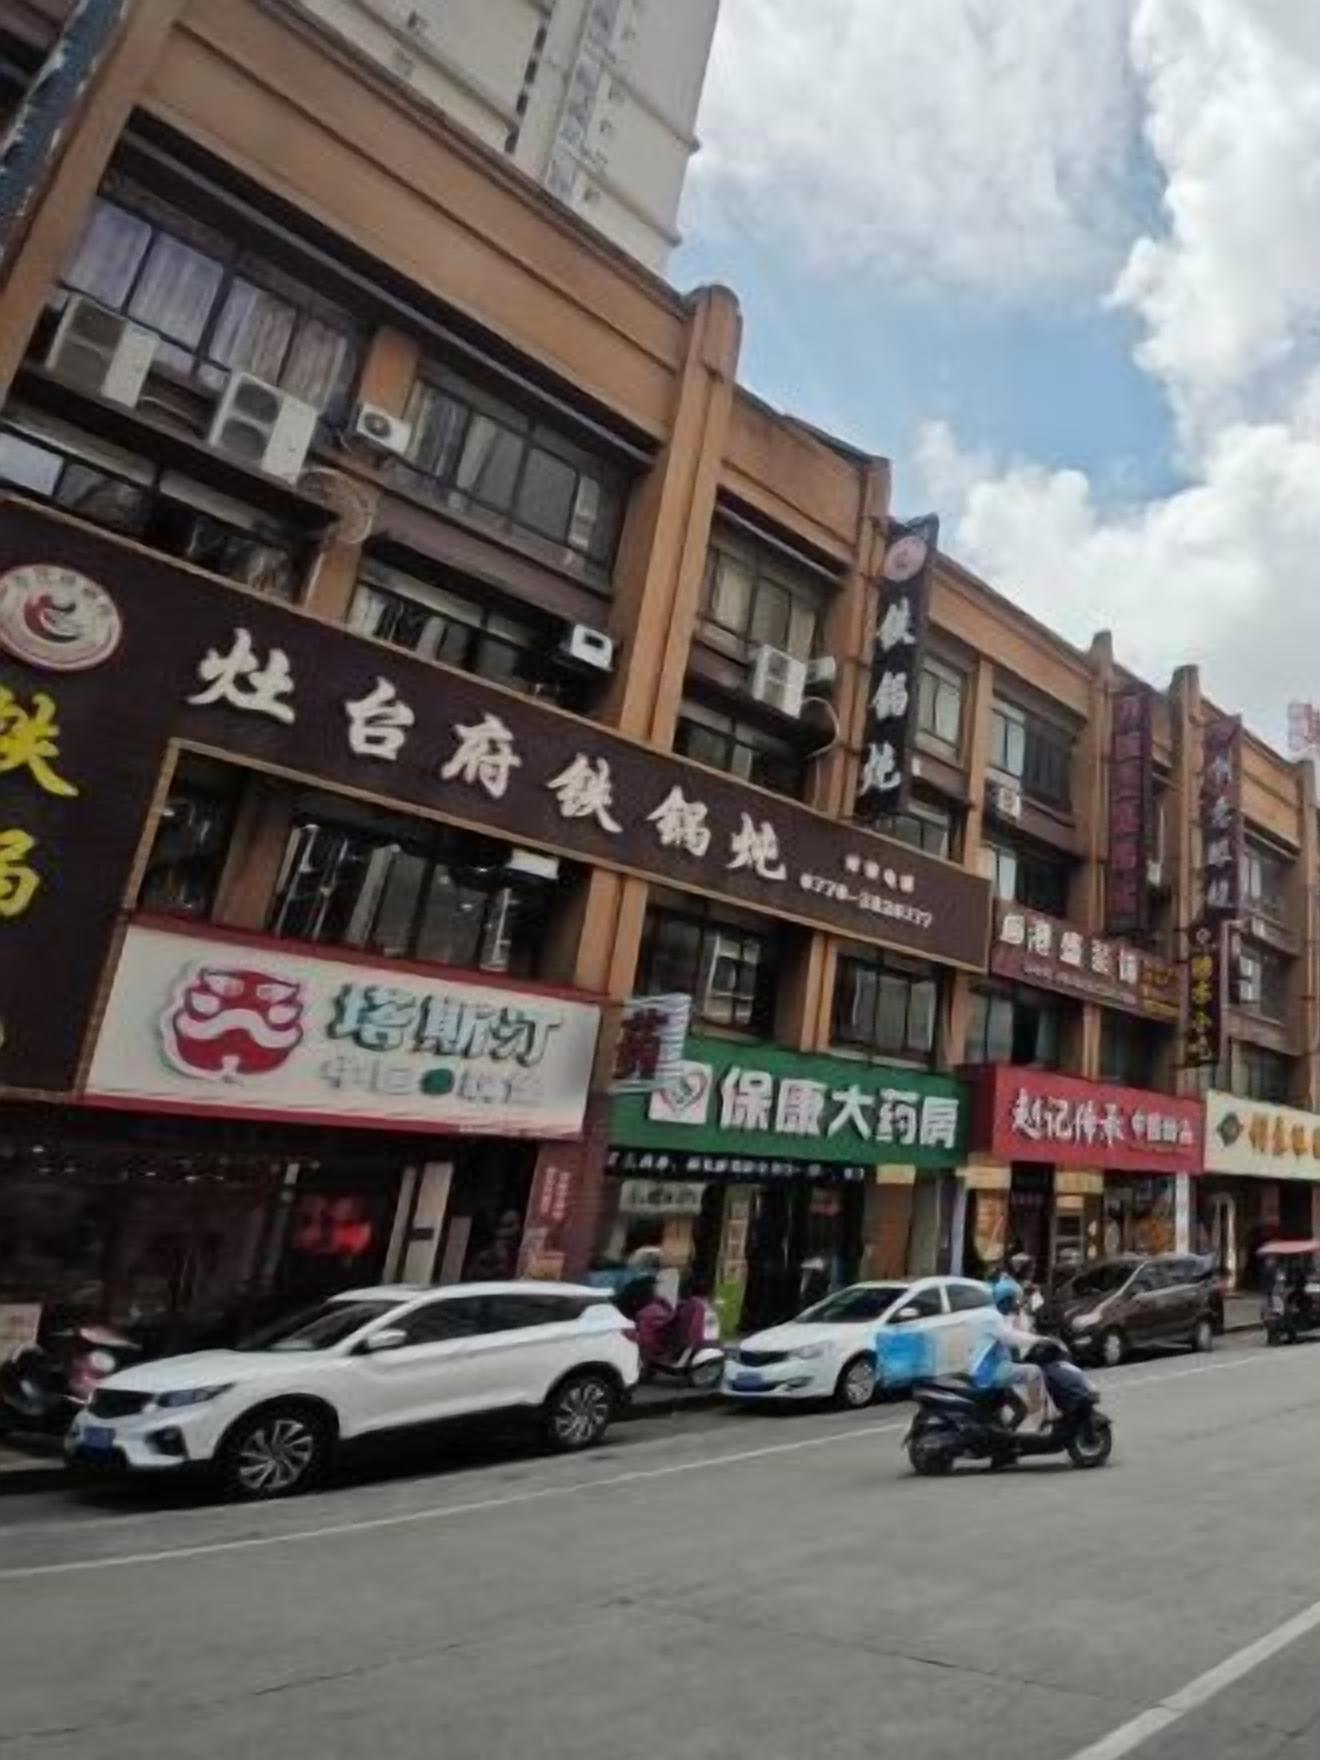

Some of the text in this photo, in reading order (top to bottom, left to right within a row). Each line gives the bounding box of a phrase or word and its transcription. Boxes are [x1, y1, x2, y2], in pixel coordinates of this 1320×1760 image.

[187, 626, 788, 882] 灶台府铁锅炖
[720, 1067, 960, 1149] 保康大药房
